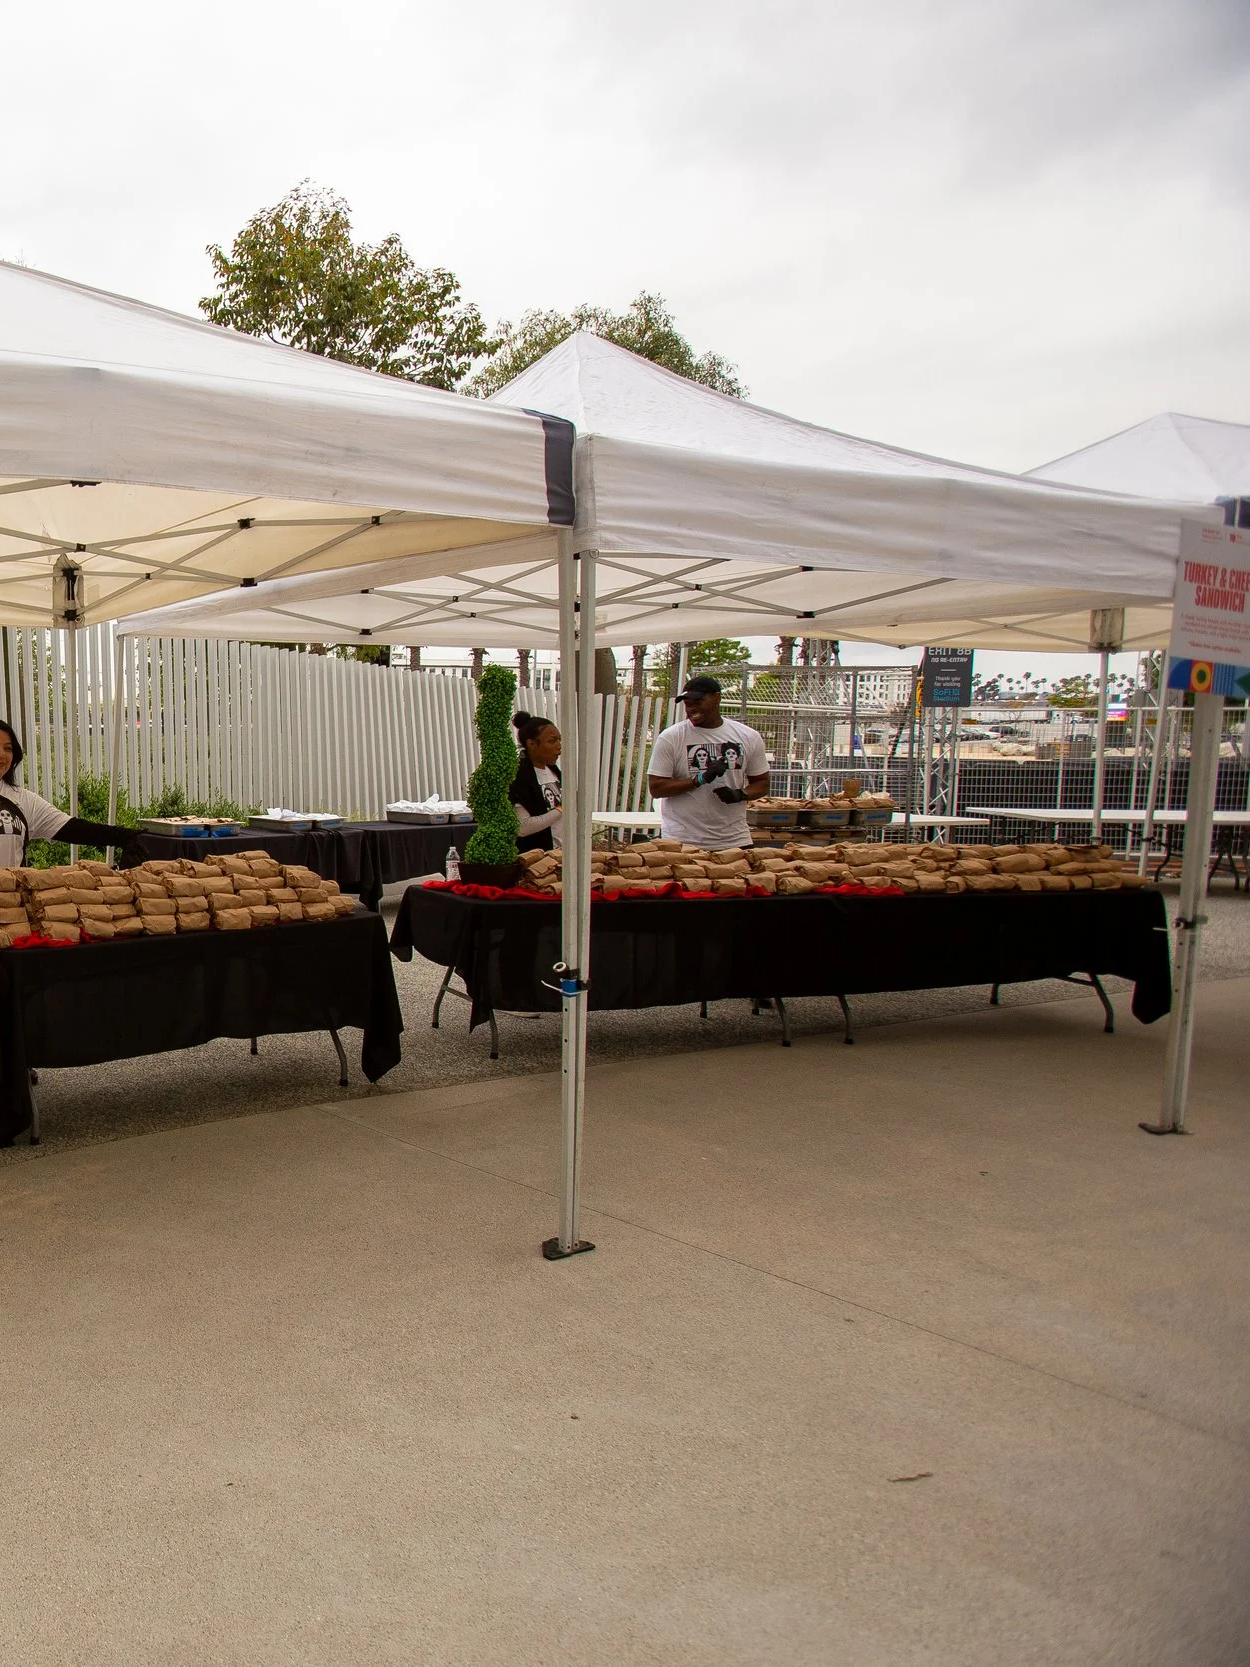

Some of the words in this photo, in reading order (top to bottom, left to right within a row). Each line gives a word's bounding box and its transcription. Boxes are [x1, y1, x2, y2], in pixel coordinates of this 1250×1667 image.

[1184, 561, 1218, 586] TURKEY
[1220, 568, 1227, 588] &
[1195, 585, 1245, 612] SANDWICH
[929, 647, 951, 655] EXIT
